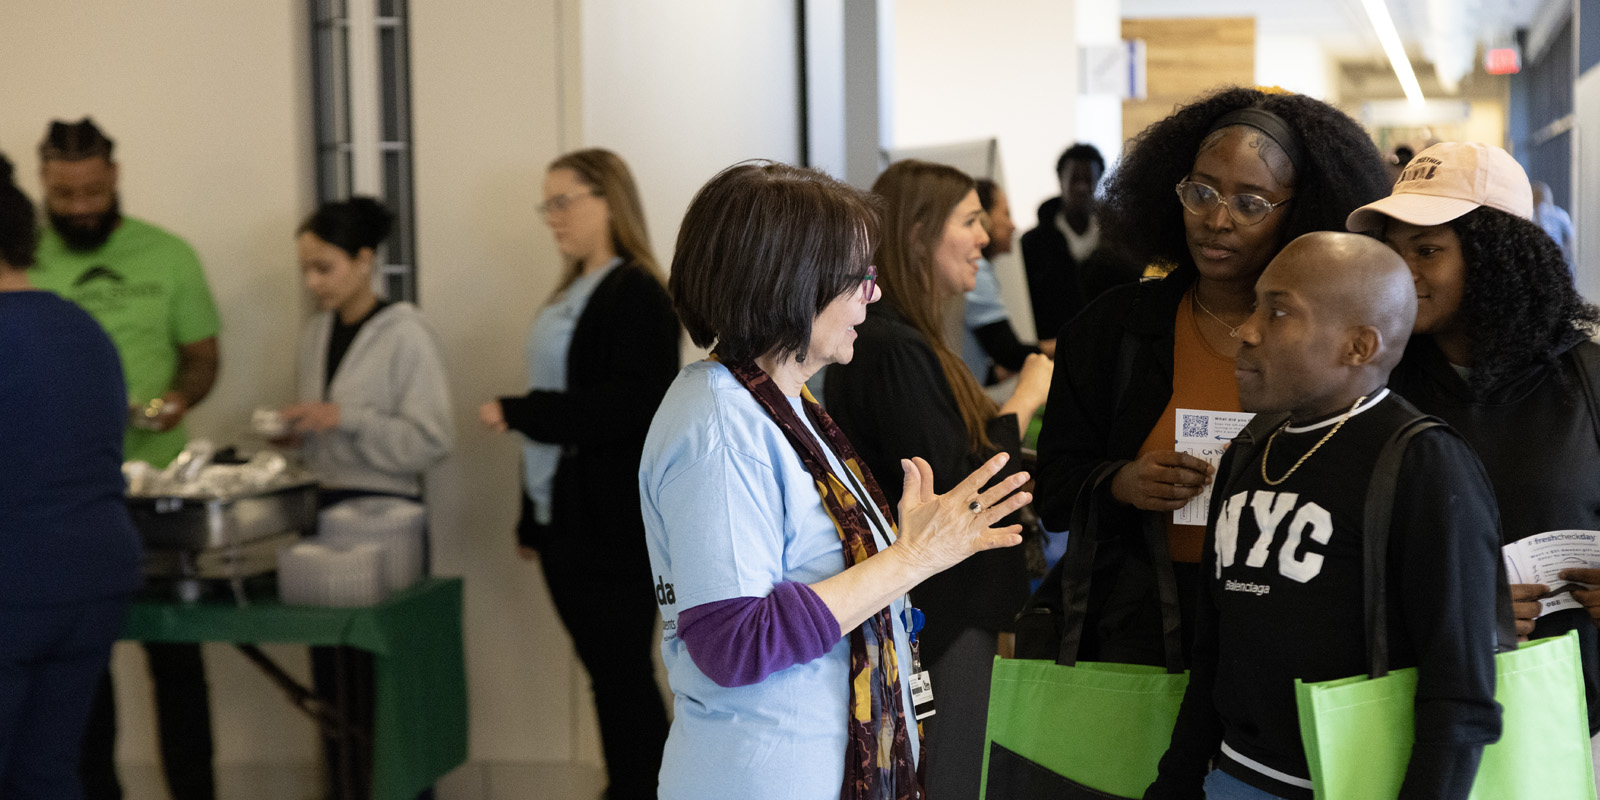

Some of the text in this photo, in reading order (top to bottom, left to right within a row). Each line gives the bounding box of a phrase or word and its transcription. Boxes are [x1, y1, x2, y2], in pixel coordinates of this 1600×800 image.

[1215, 490, 1333, 583] NYC
[1534, 533, 1596, 544] freshcheckday
[656, 575, 676, 606] da
[1225, 580, 1270, 595] Balenciaga
